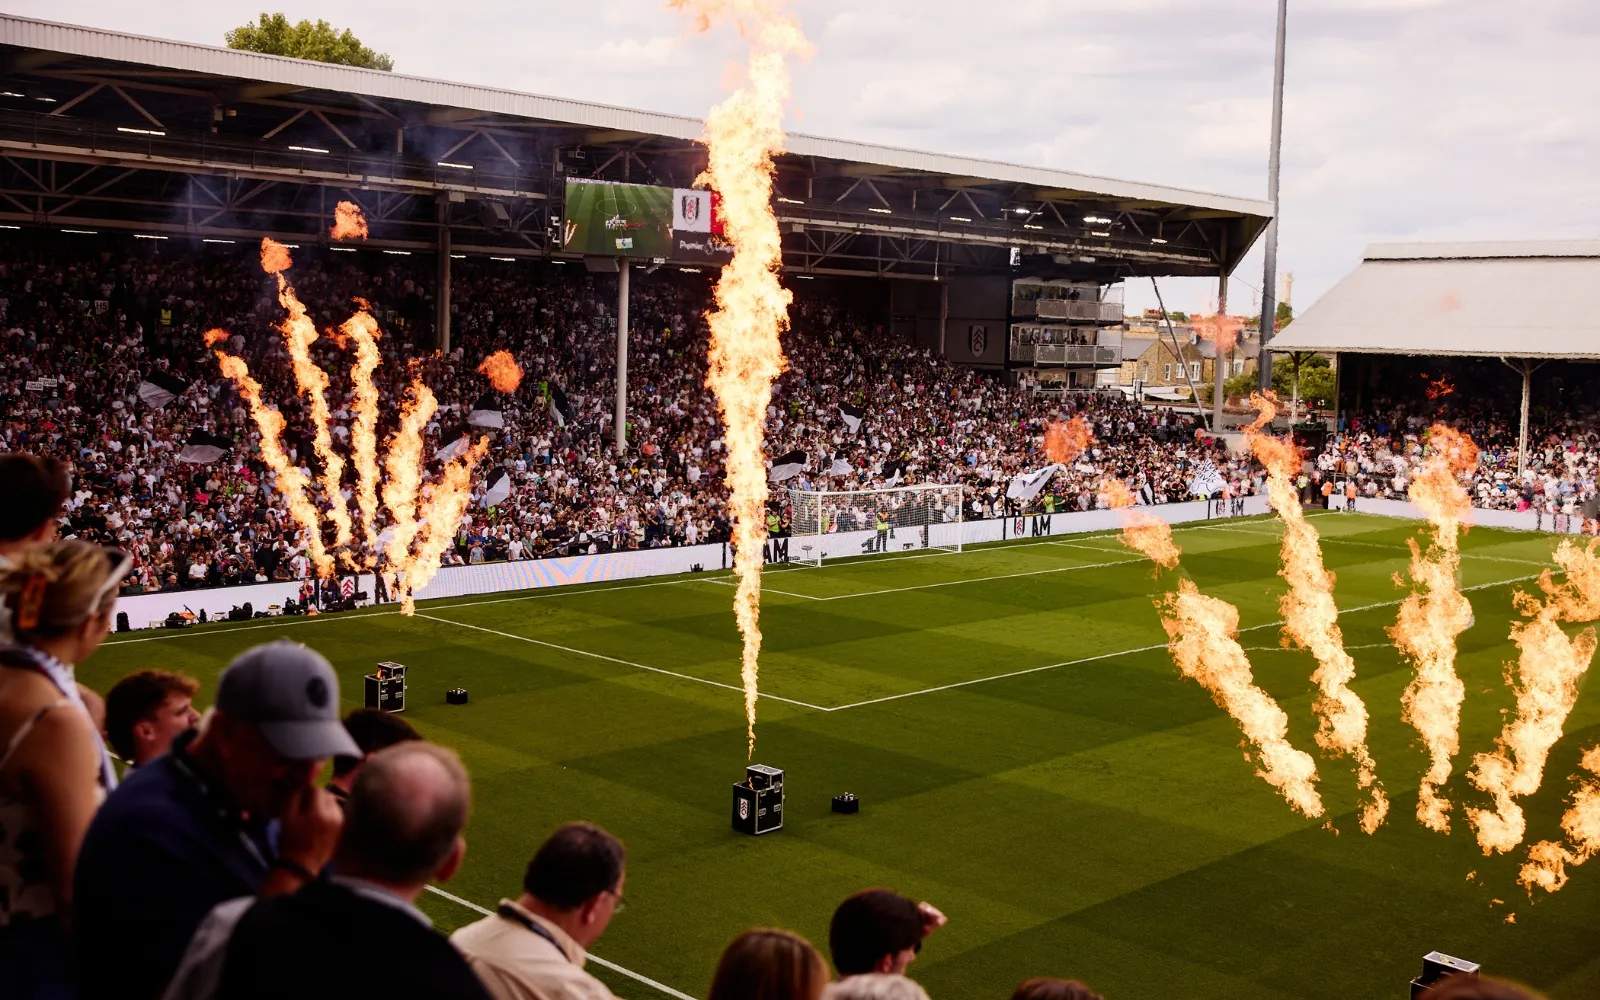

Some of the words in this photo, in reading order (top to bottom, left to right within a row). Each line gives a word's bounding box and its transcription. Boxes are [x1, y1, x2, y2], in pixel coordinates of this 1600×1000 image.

[679, 240, 704, 250] Premier
[1032, 514, 1051, 537] AM
[762, 538, 788, 564] AM
